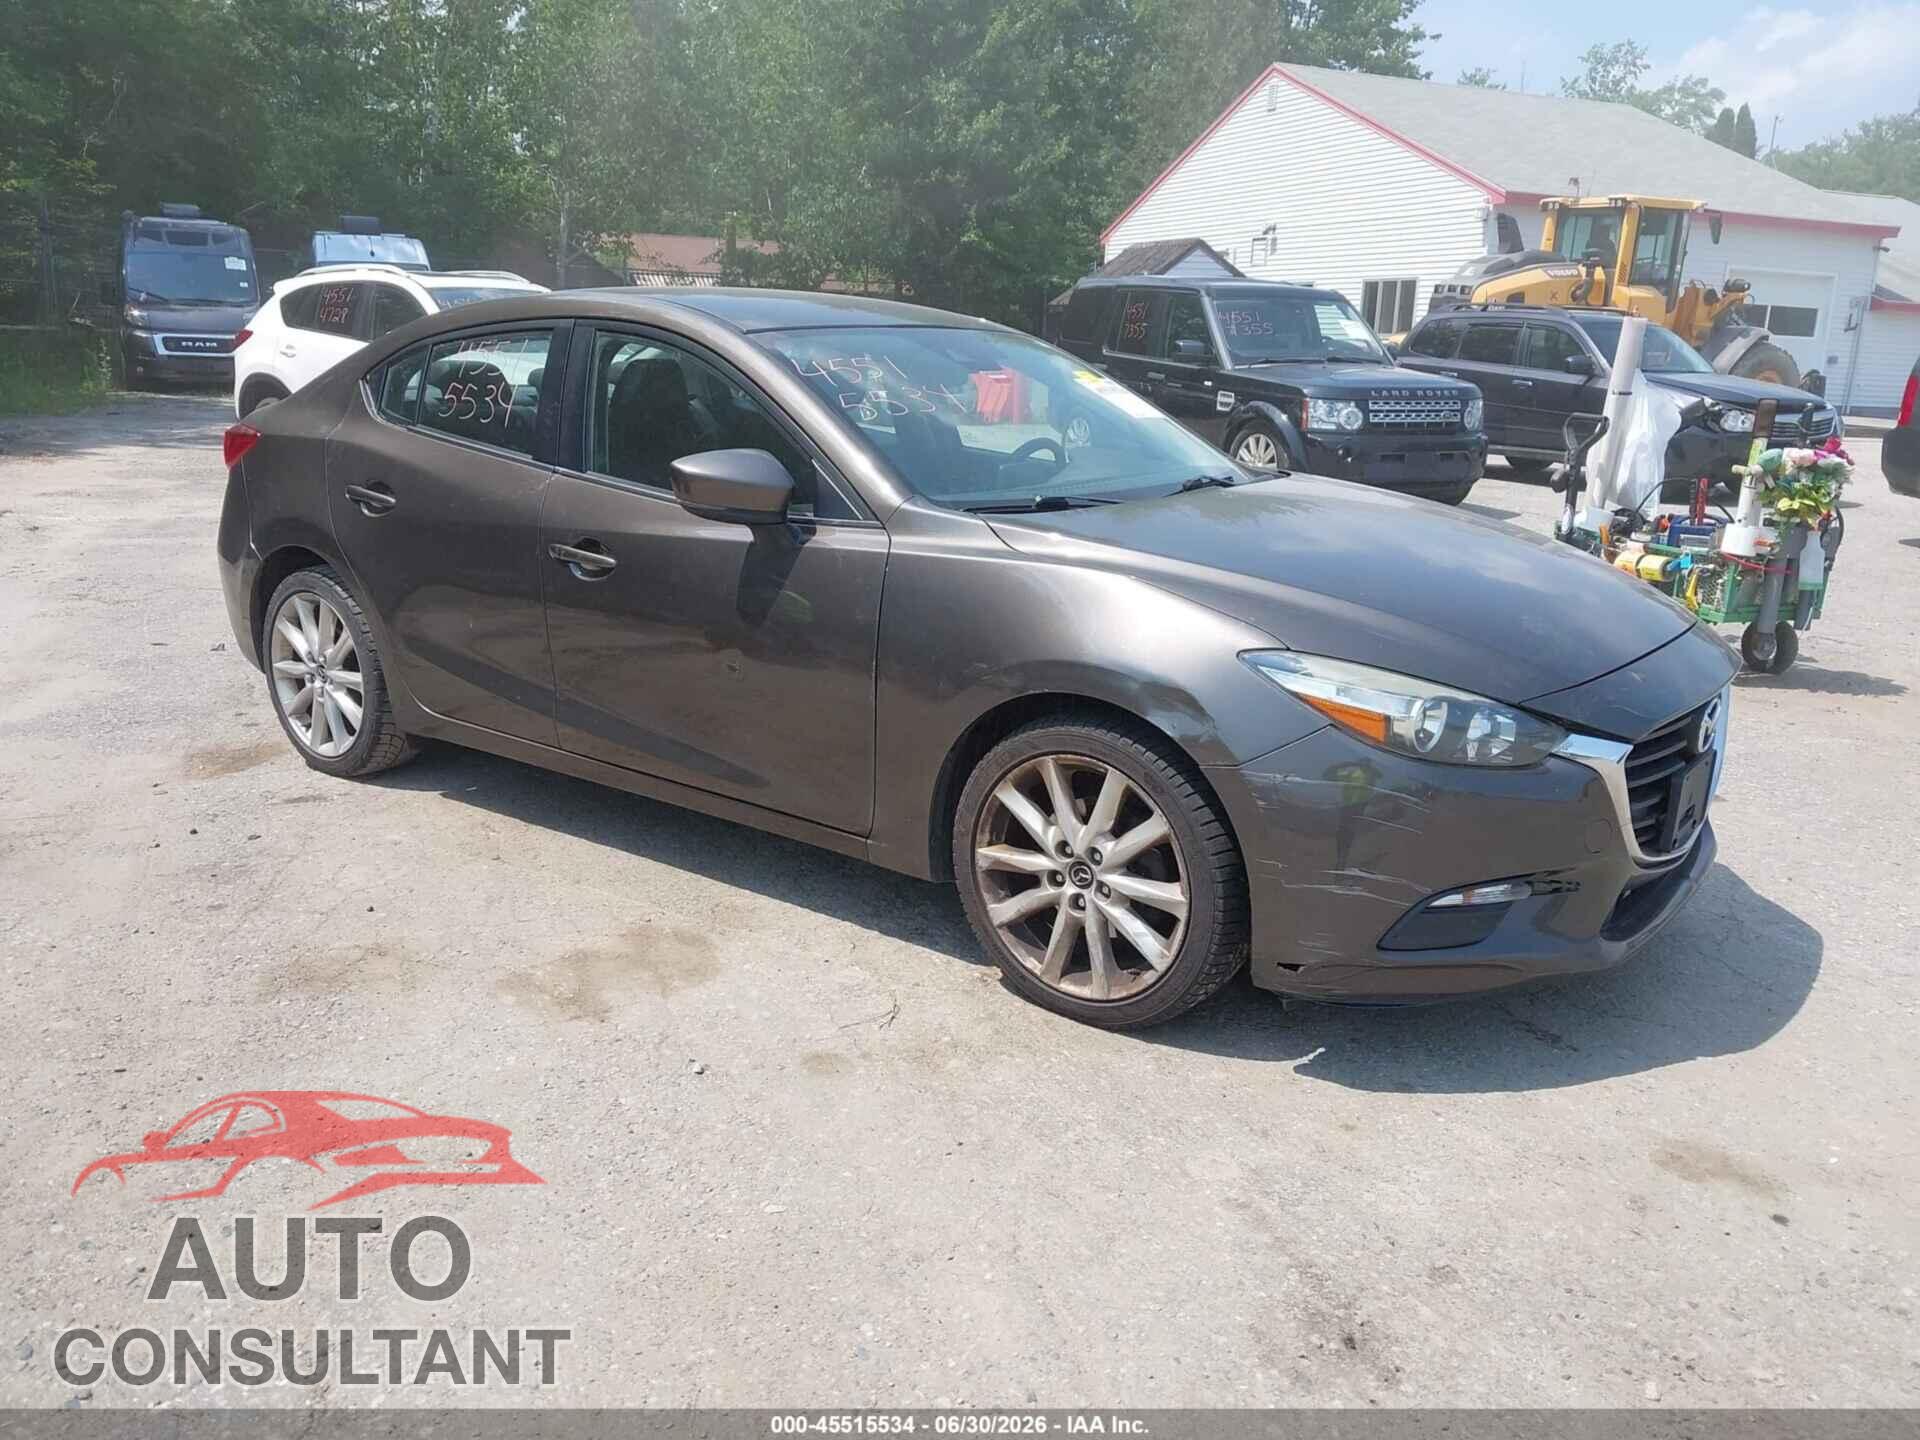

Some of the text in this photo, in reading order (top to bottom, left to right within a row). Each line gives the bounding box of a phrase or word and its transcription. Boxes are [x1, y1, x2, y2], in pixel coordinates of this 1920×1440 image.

[791, 352, 908, 387] 4551
[438, 381, 519, 430] 5534
[838, 382, 967, 421] 5534
[1371, 389, 1459, 398] LAND ROVER
